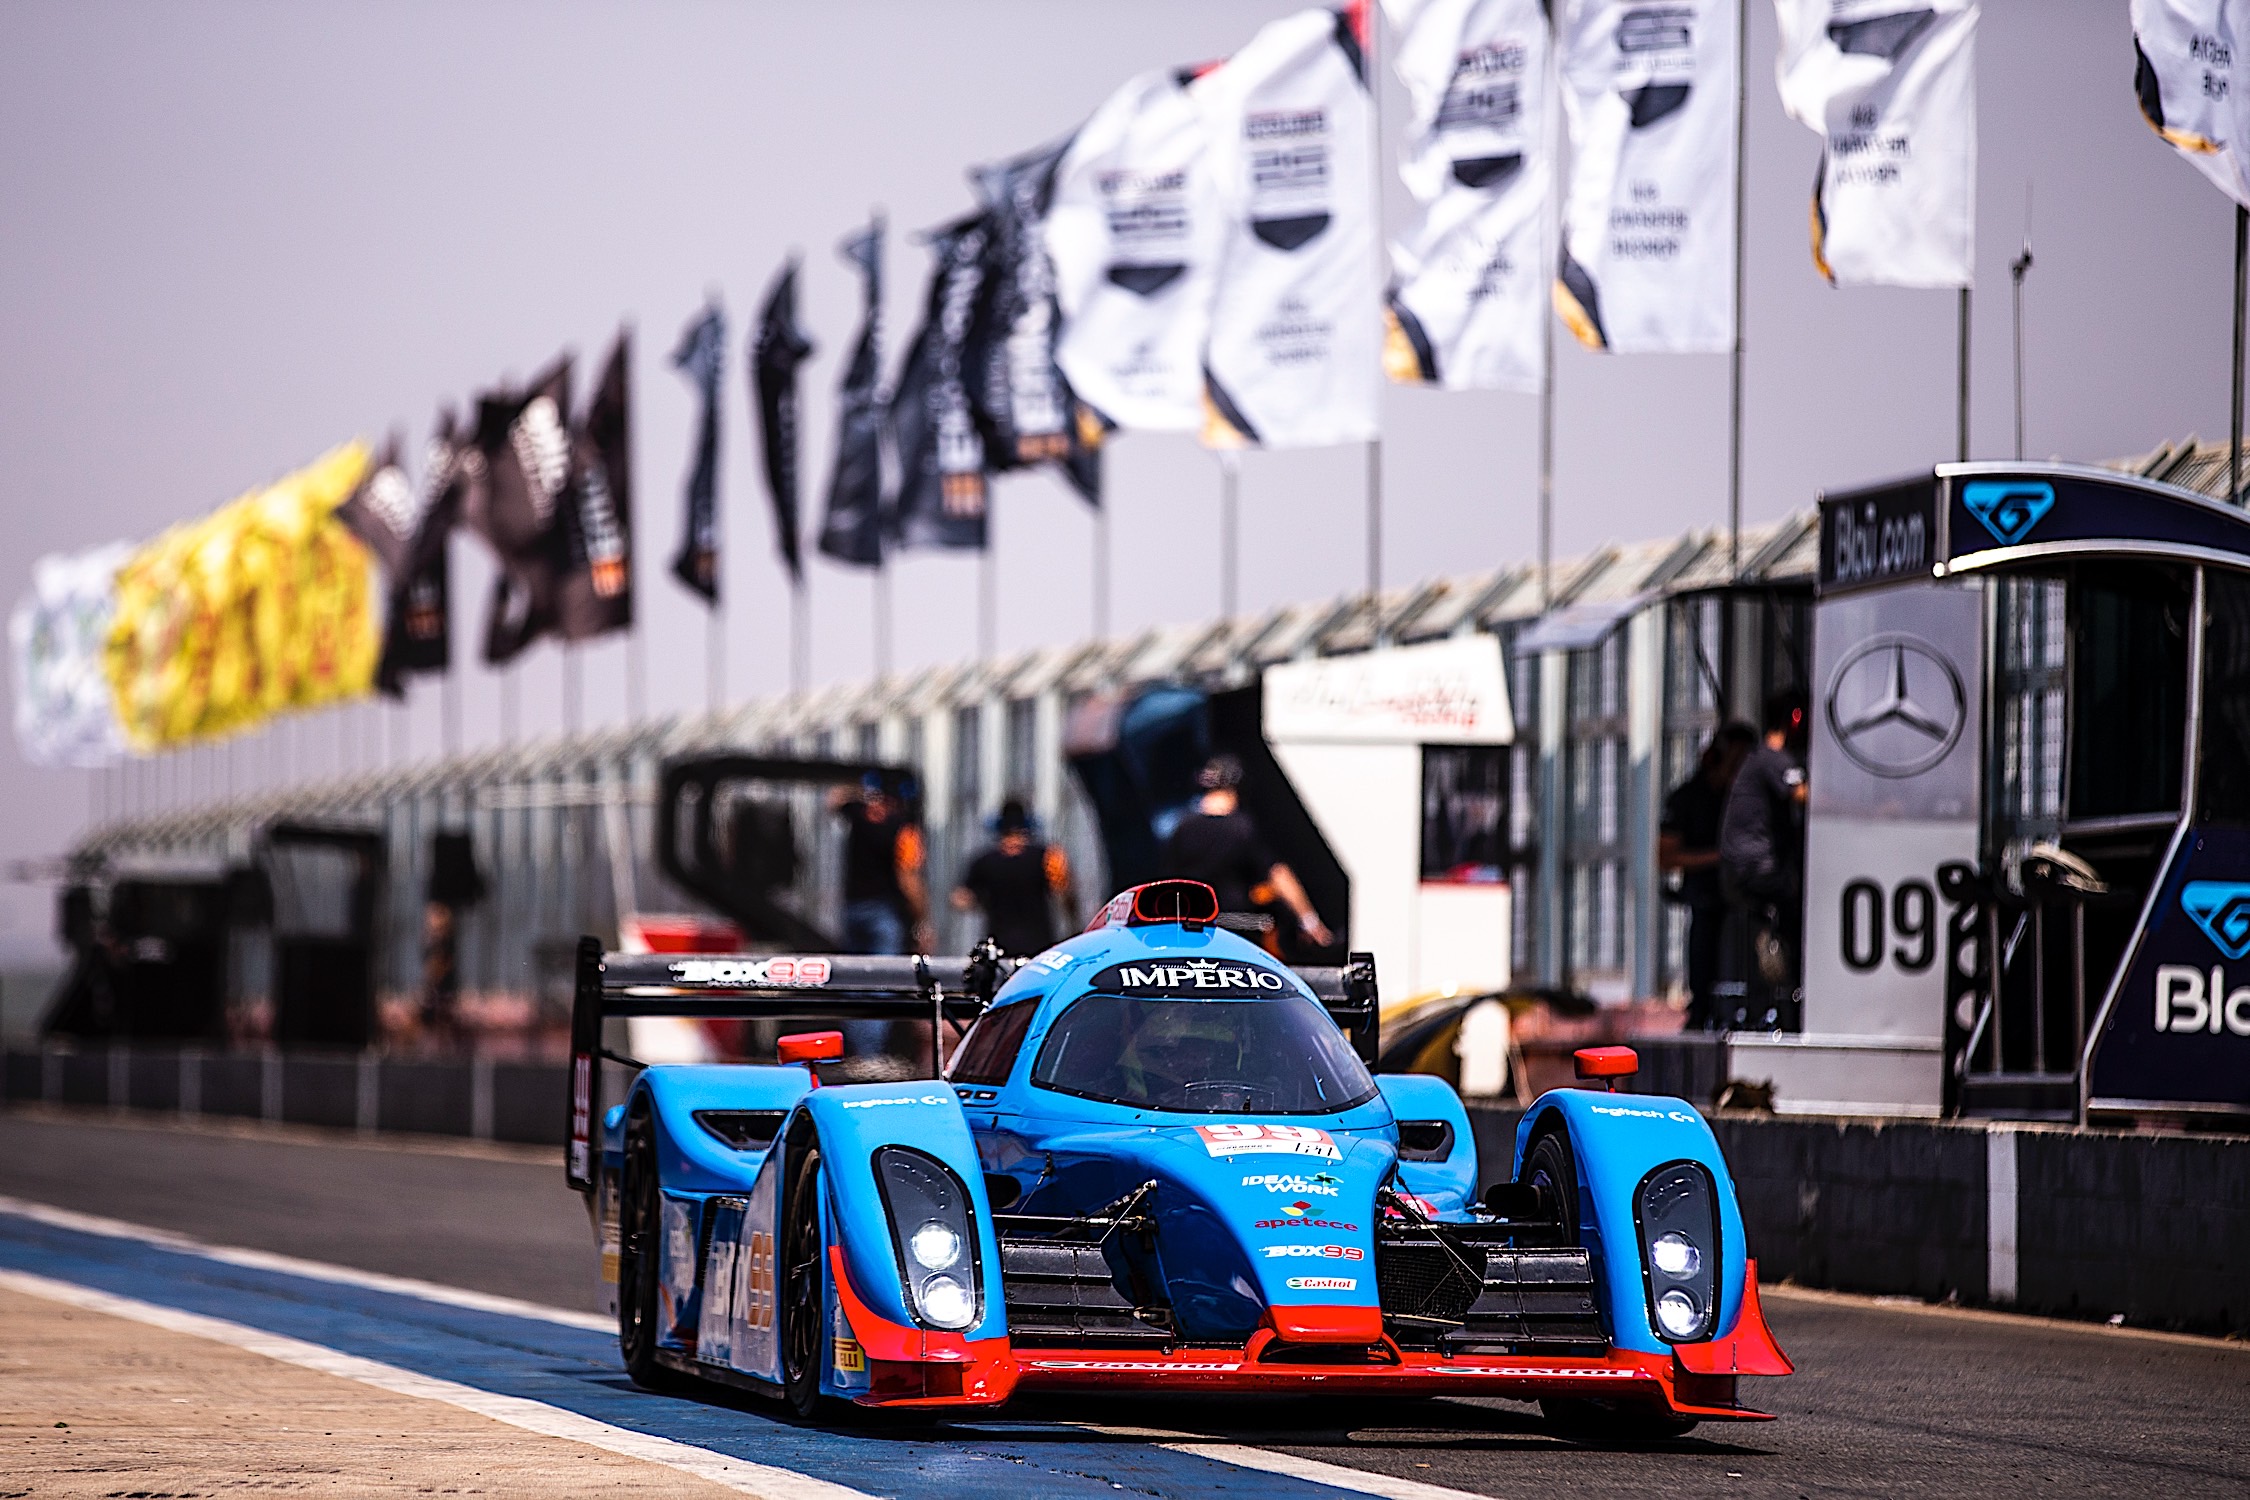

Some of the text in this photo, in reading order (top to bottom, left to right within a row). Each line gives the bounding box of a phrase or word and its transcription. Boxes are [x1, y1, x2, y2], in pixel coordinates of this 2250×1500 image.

[1842, 878, 1936, 974] 09
[1242, 1174, 1308, 1186] IDEAL
[1265, 1183, 1339, 1197] WORK
[1255, 1217, 1358, 1232] apetece
[1260, 1244, 1364, 1261] BOX99
[1303, 1279, 1351, 1289] Castrol
